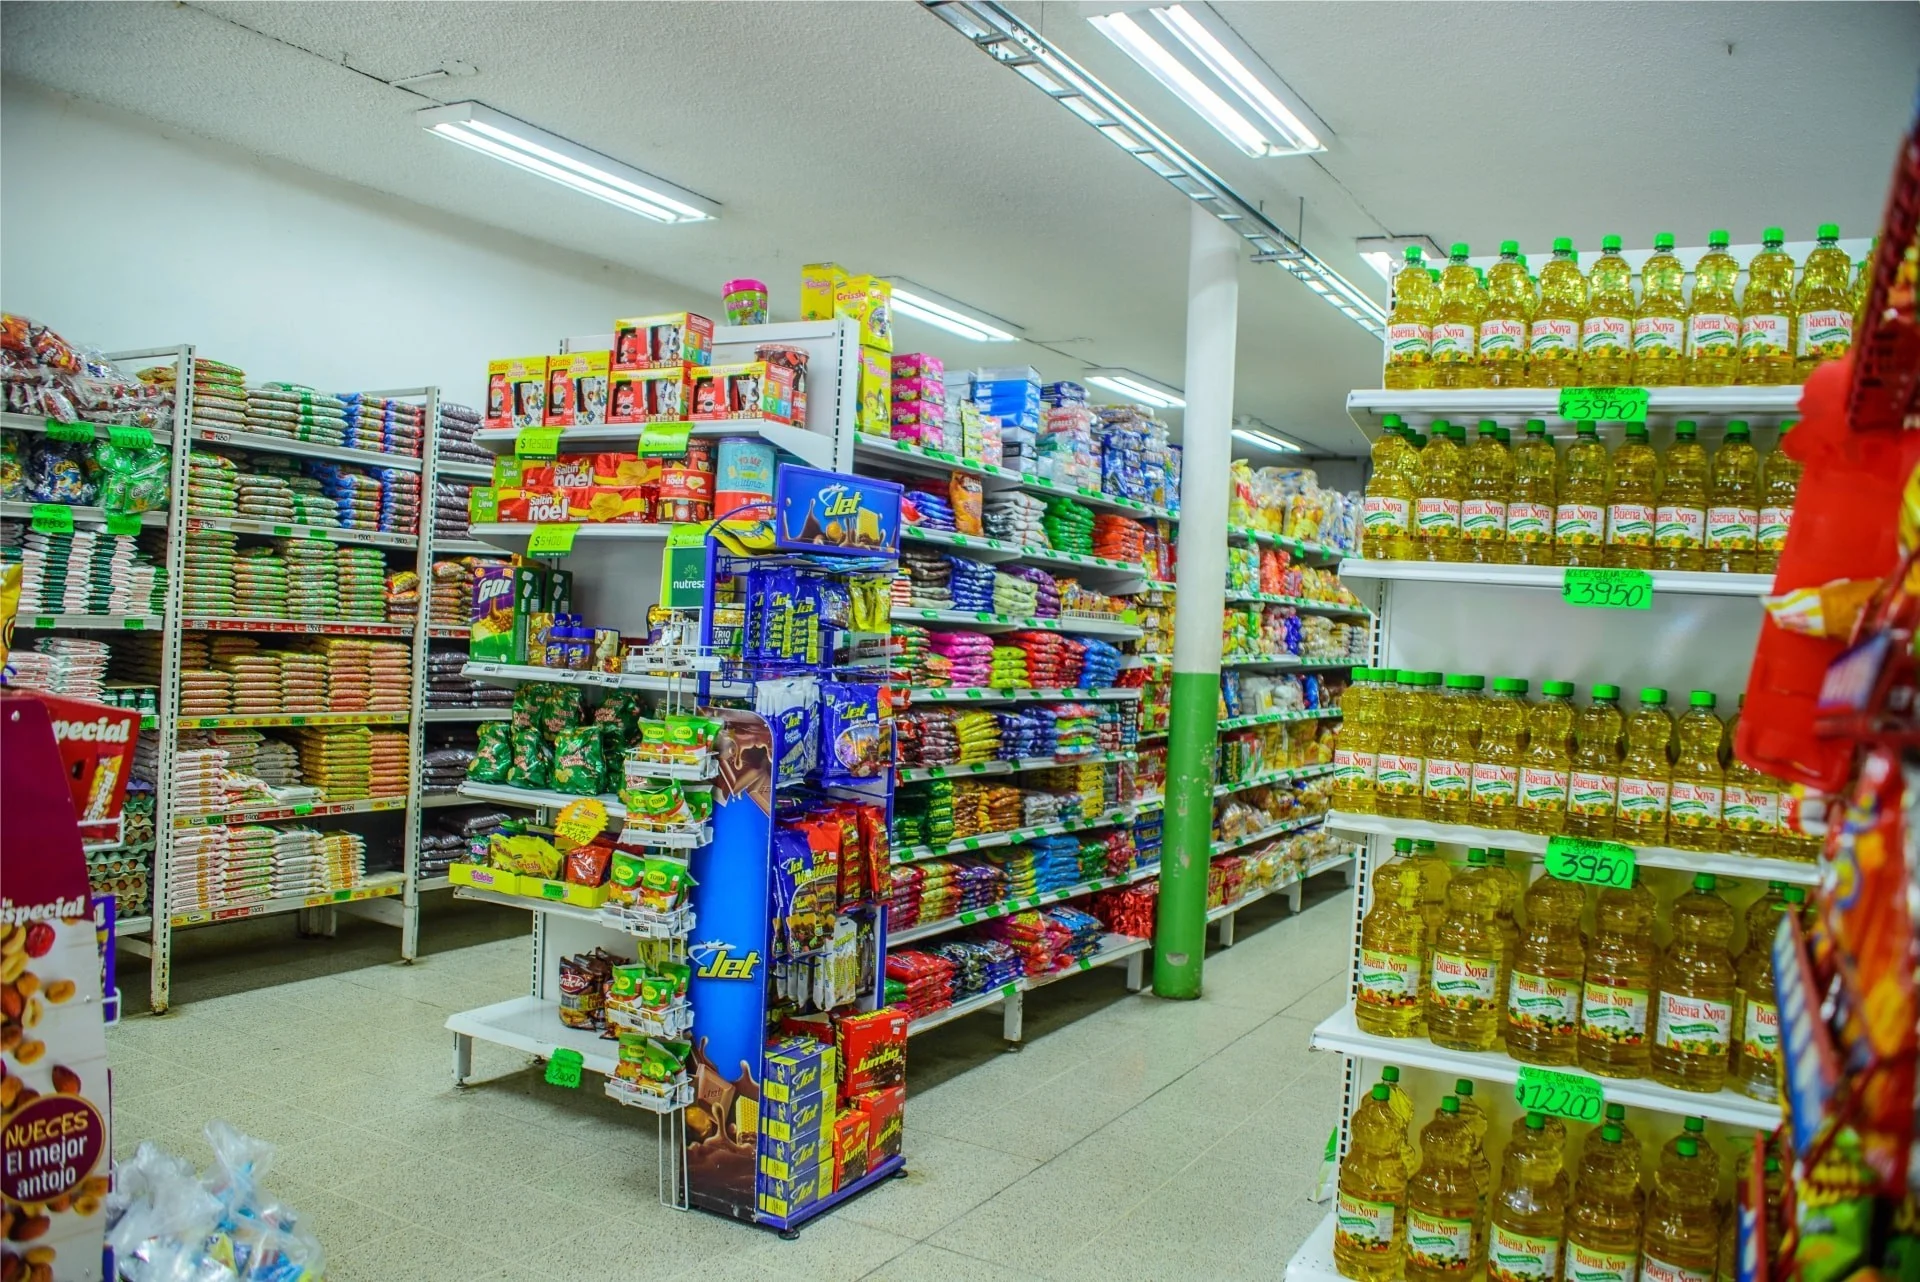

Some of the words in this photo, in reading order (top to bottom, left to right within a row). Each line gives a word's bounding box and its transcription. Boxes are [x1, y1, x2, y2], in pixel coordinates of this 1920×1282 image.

[1444, 323, 1464, 338] Soya
[1502, 321, 1521, 335] Soya
[1550, 321, 1571, 335] Soya
[1604, 318, 1624, 333] Soya
[1652, 318, 1675, 333] Soya
[1752, 315, 1776, 330] Soya
[555, 464, 579, 475] Saltin
[555, 467, 594, 487] noel
[530, 496, 553, 506] Saltin
[825, 491, 862, 517] Jet
[1382, 498, 1402, 513] Soya
[1485, 500, 1504, 515] Soya
[528, 498, 569, 522] noel
[1530, 503, 1550, 519] Soya
[1577, 506, 1597, 520] Soya
[1613, 507, 1641, 520] Buena
[1676, 509, 1696, 524] Soya
[1710, 510, 1735, 523] Buena
[478, 577, 512, 604] GOL
[714, 629, 731, 639] TRIO
[842, 703, 869, 719] Jet
[52, 717, 131, 744] pecial
[1353, 752, 1372, 767] Soya
[1399, 758, 1418, 772] Soya
[1428, 759, 1451, 775] Buena
[1474, 764, 1497, 779] Buena
[1525, 769, 1551, 786] Buena
[1572, 773, 1599, 790] Buena
[1620, 780, 1644, 795] Buena
[1694, 785, 1715, 802] Soya
[1745, 791, 1767, 806] Soya
[650, 873, 665, 882] TOSH
[1558, 852, 1628, 886] 3950
[697, 949, 760, 980] Jet
[1364, 952, 1384, 970] Buena
[1387, 957, 1408, 973] Soya
[1436, 955, 1462, 976] Buena
[1464, 961, 1488, 979] Soya
[1519, 976, 1544, 995] Buena
[1546, 982, 1566, 997] Soya
[1587, 986, 1608, 1005] Buena
[1611, 990, 1633, 1008] Soya
[1668, 997, 1699, 1018] Buena
[1703, 1002, 1726, 1021] Soya
[853, 1047, 900, 1075] Jumbo
[795, 1066, 817, 1091] Jet
[797, 1103, 819, 1128] Jet
[6, 1110, 88, 1150] NUECES
[872, 1119, 900, 1150] Jumbo
[7, 1150, 22, 1176] El
[29, 1135, 88, 1169] mejor
[17, 1160, 76, 1199] antojo
[1359, 1203, 1378, 1218] Soya
[1413, 1218, 1435, 1233] Buena
[1438, 1221, 1458, 1236] Soya
[1498, 1232, 1523, 1250] Buena
[1525, 1238, 1546, 1254] Soya
[1576, 1249, 1603, 1269] Buena
[1606, 1254, 1626, 1271] Soya
[1645, 1260, 1675, 1282] Buena
